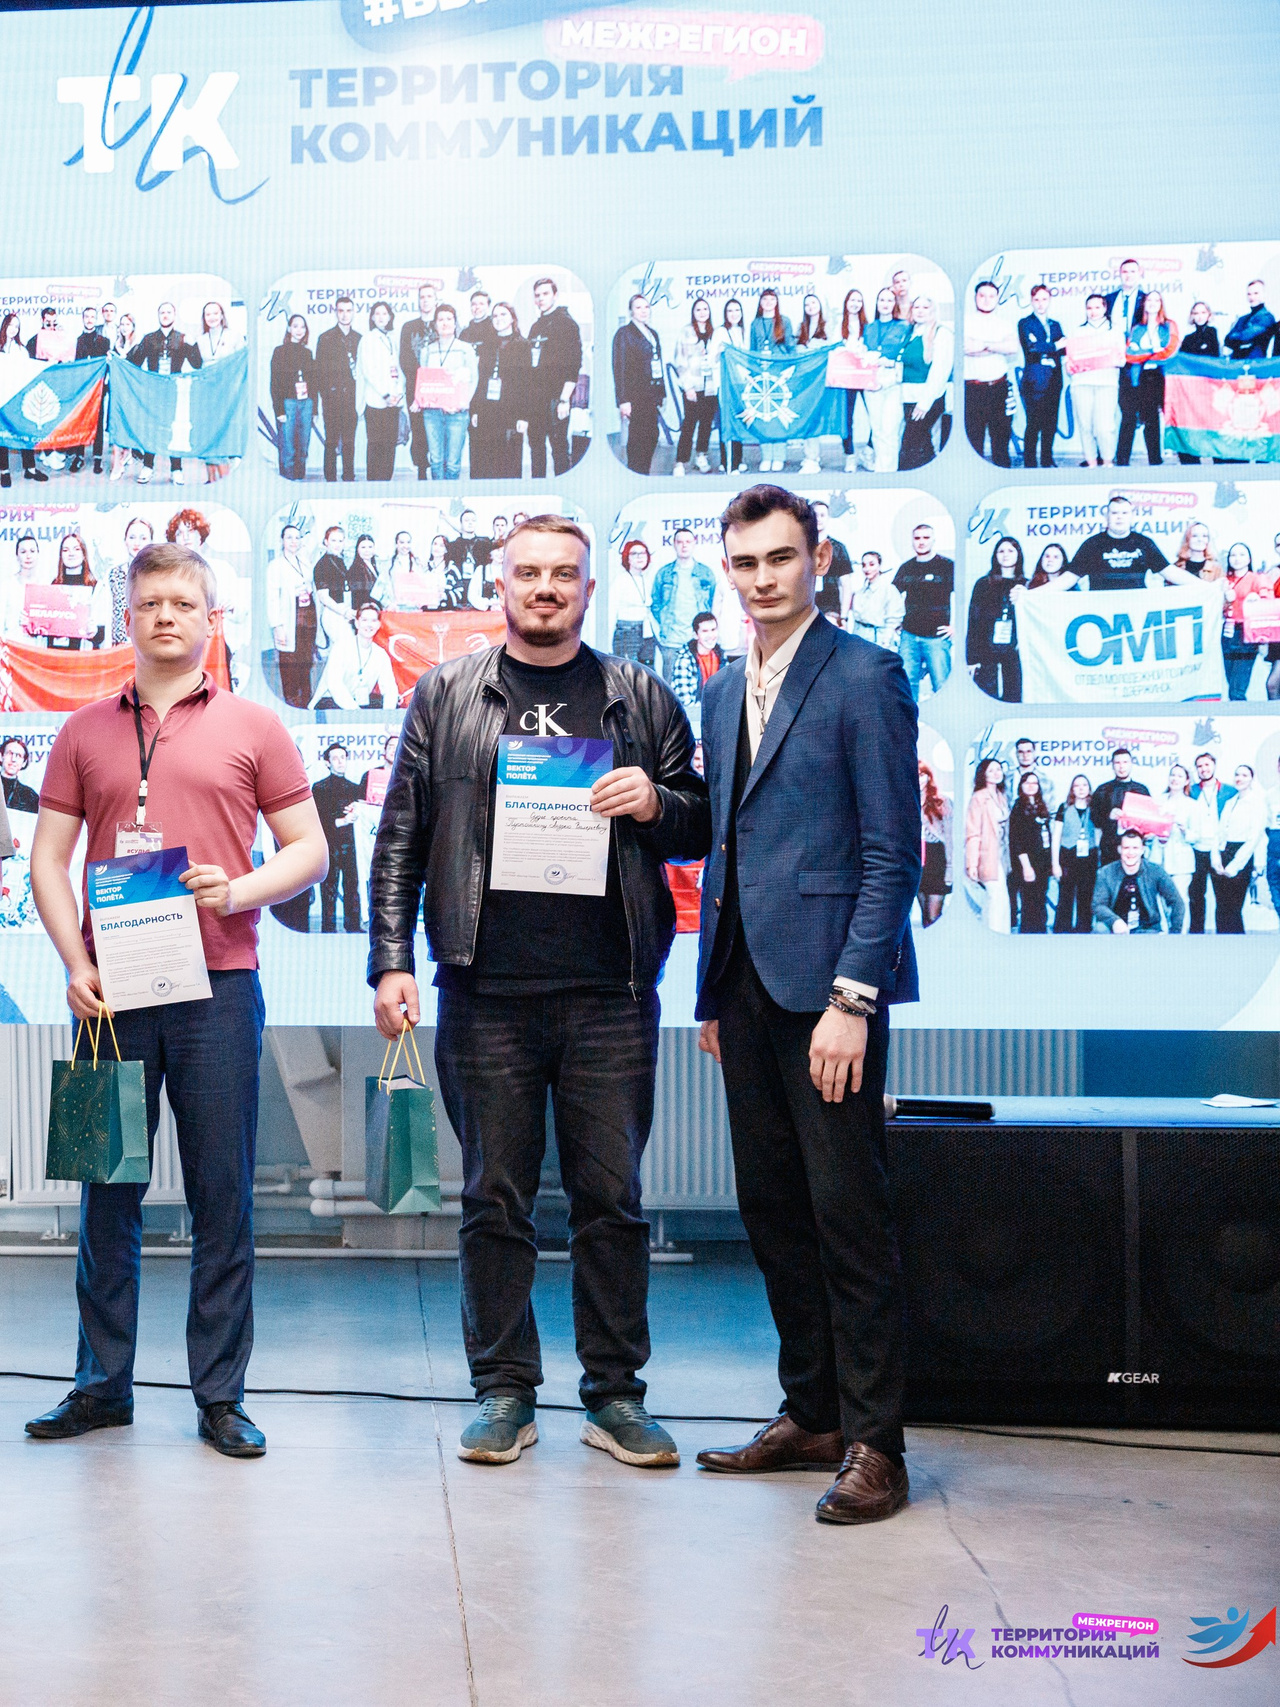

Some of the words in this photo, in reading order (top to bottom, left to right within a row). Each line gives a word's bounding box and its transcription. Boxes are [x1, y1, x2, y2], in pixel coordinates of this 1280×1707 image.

[561, 19, 807, 58] МЕЖРЕГИОН
[289, 59, 683, 110] ТЕРРИТОРИЯ
[289, 94, 823, 165] КОММУНИКАЦИЙ
[686, 273, 781, 285] ТЕРРИТОРИЯ
[307, 288, 409, 300] ТЕРРИТОРИЯ
[686, 282, 815, 300] КОММУНИАЦИЙ
[1027, 505, 1153, 519] ТЕРРИТОИЯ
[1065, 606, 1203, 667] ОМП
[506, 764, 537, 772] ВЕКТОР
[506, 772, 537, 780] ПОЛЁТА
[95, 886, 122, 896] ВЕКТОР
[96, 893, 124, 903] ПОЛЁТА
[100, 912, 183, 931] БЛАГОДАРНОСТЬ
